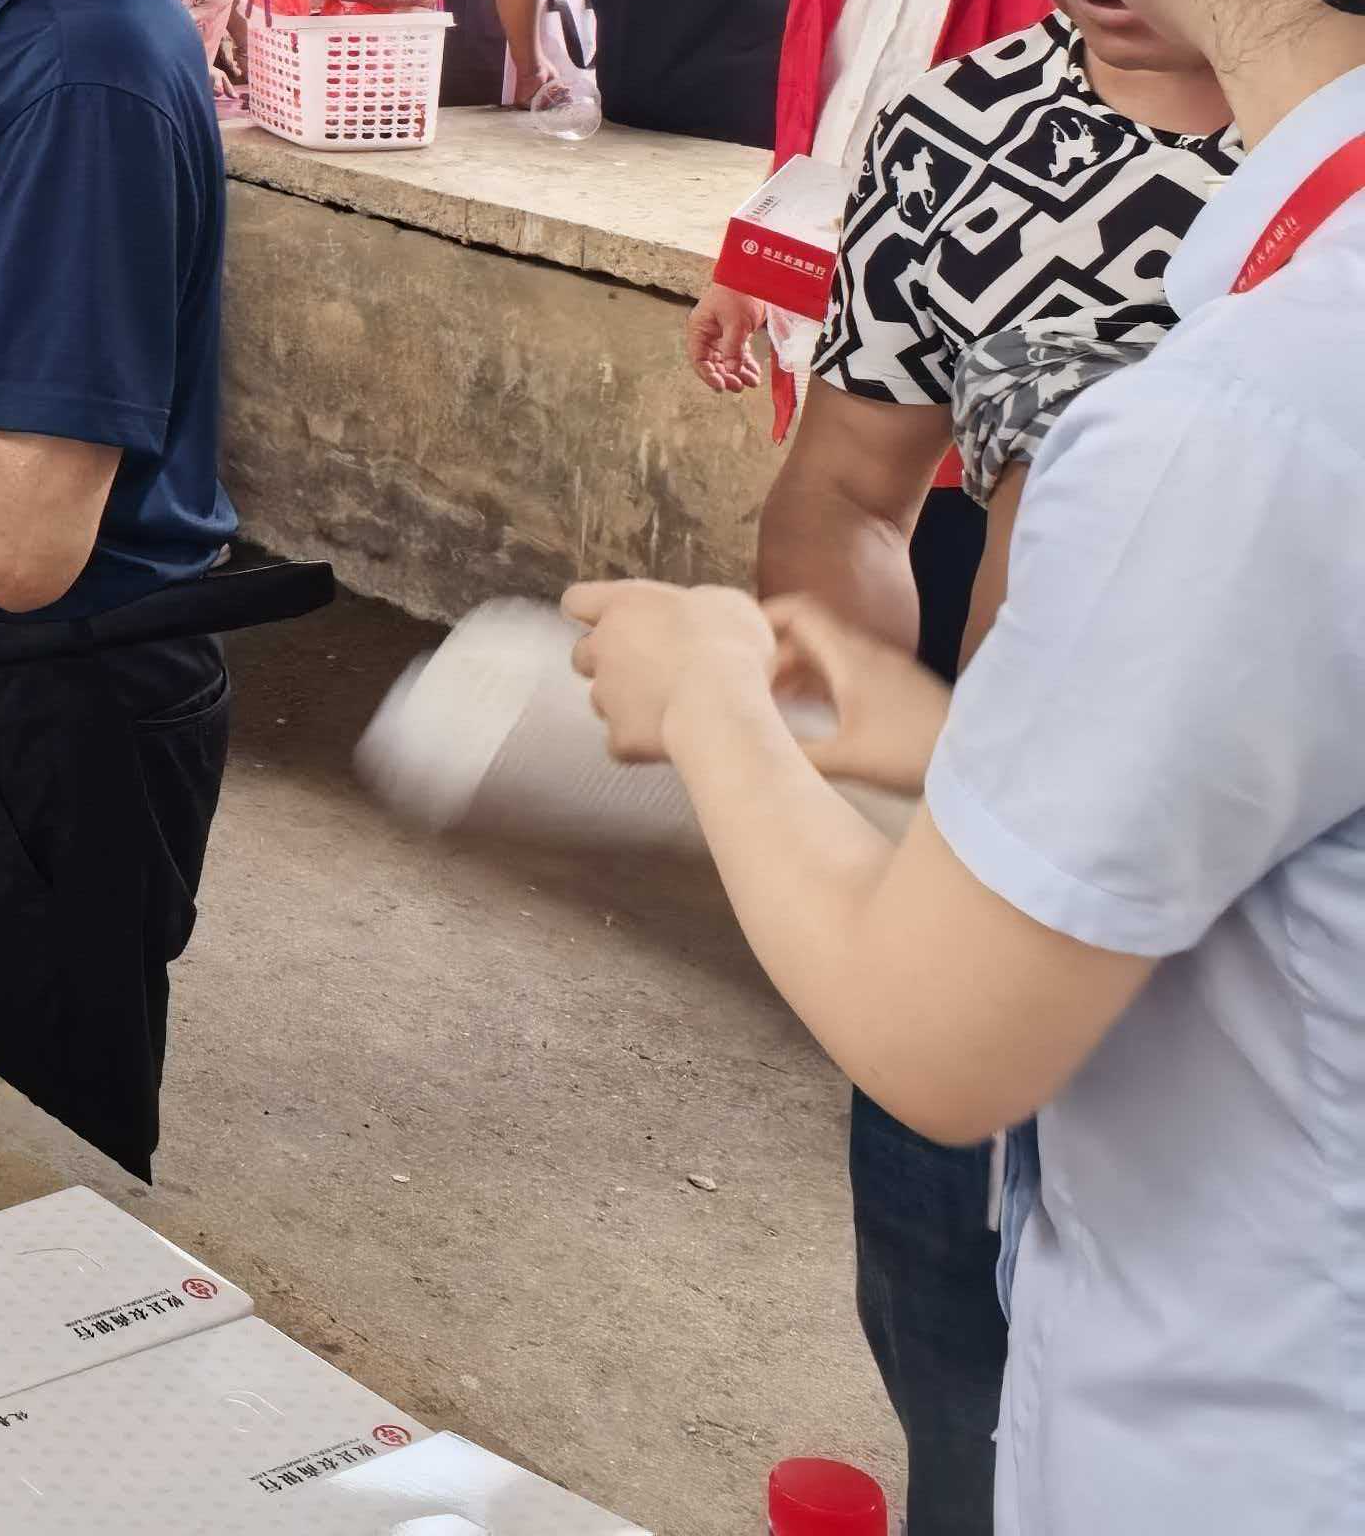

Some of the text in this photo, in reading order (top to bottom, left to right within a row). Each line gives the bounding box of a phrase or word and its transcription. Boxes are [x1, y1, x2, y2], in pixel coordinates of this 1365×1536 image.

[73, 1294, 186, 1341] 攸县农商银行
[260, 1442, 377, 1495] 攸县农商银行
